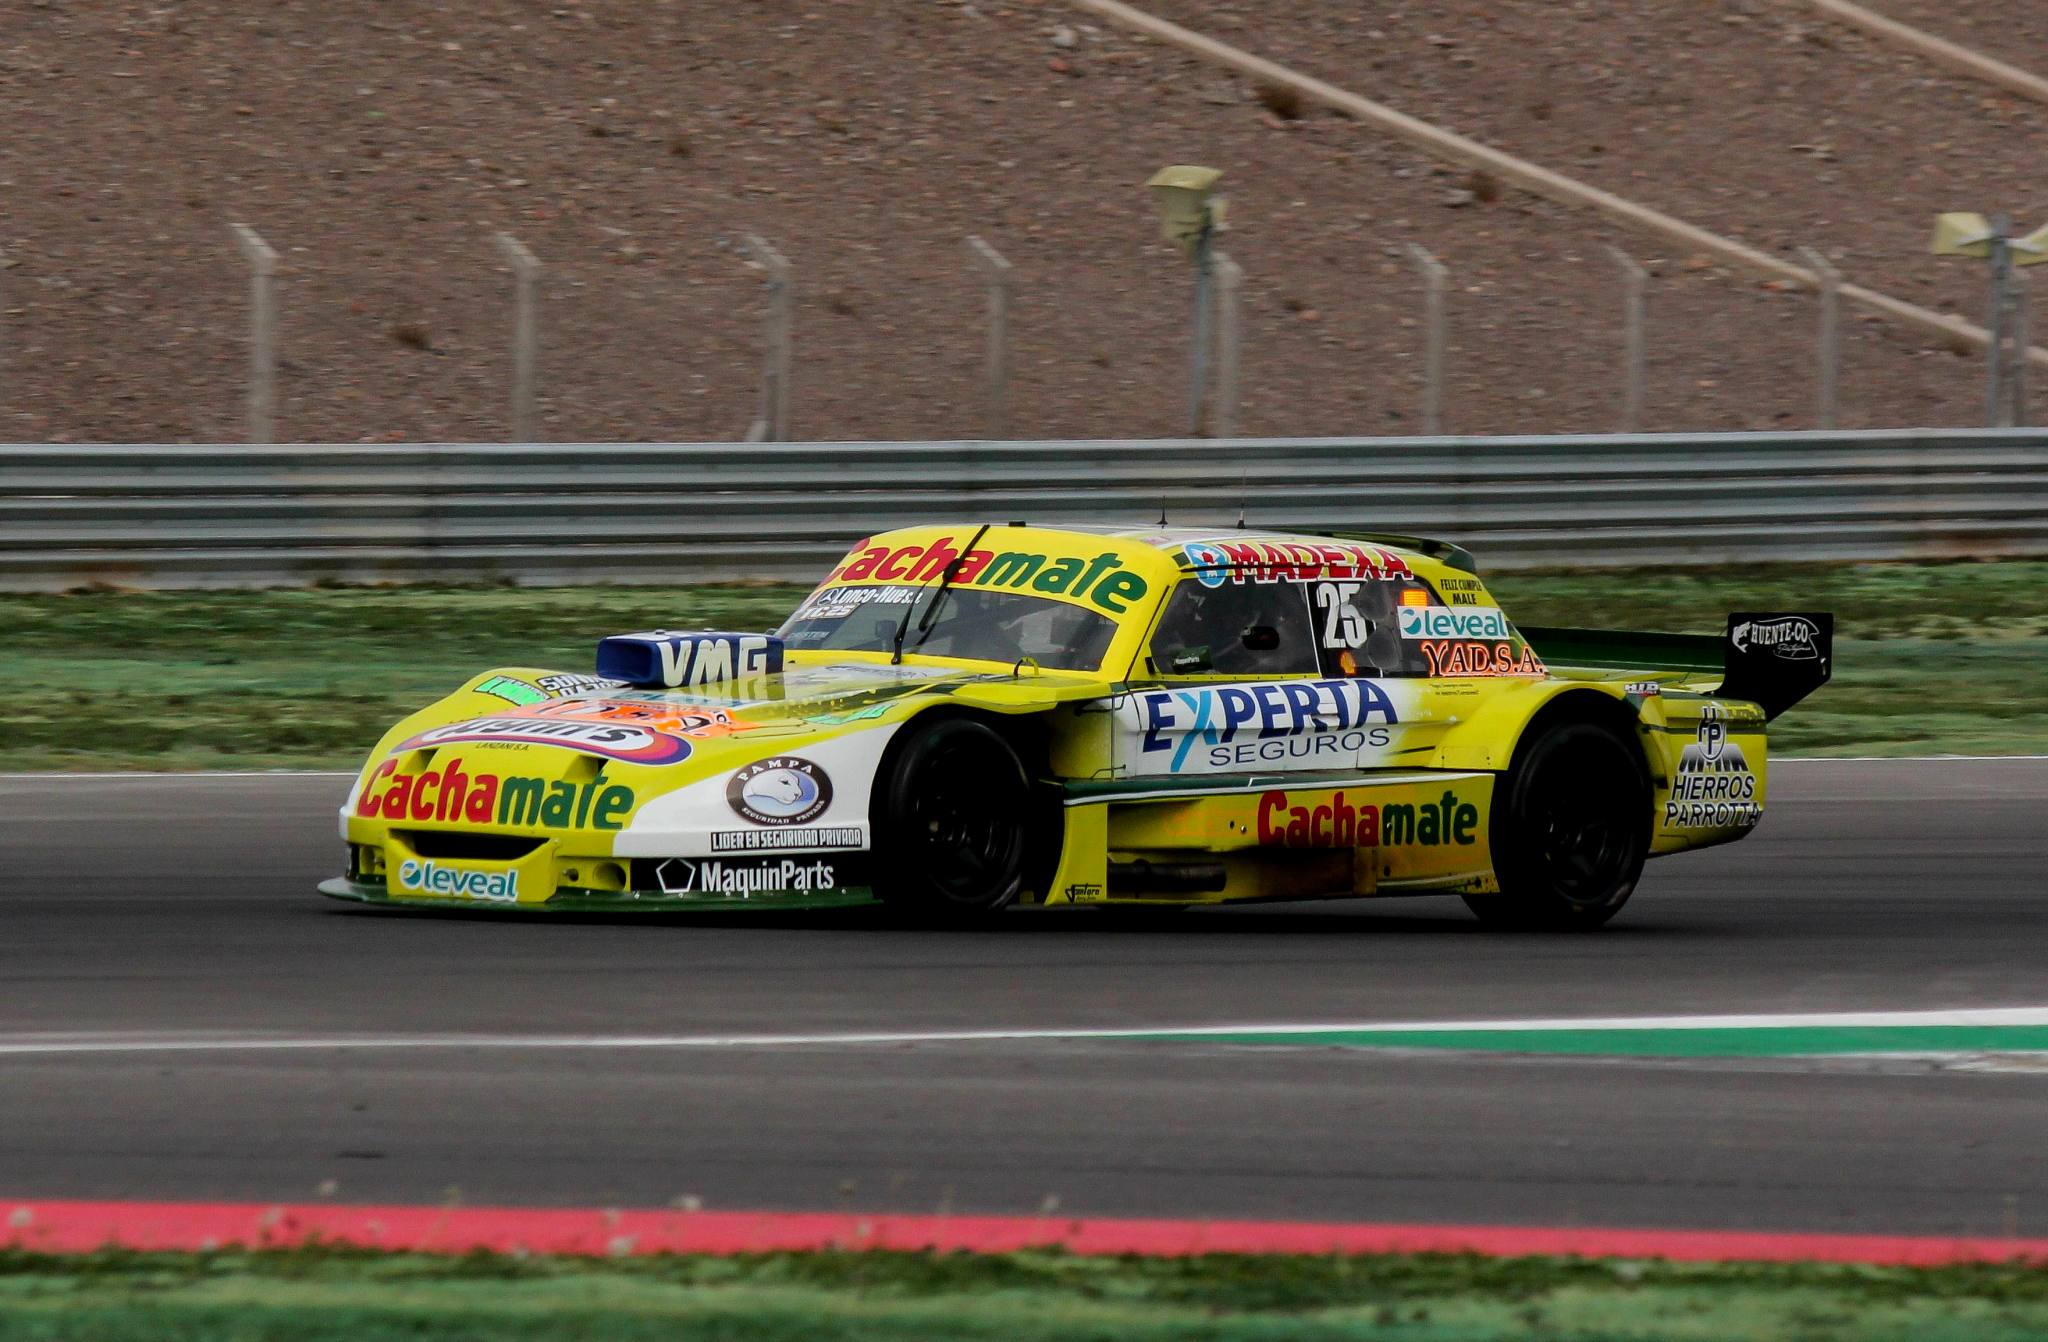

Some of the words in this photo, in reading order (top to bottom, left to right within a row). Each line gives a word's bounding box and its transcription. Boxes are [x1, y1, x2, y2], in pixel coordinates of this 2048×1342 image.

[819, 537, 1148, 614] Cachamate
[1217, 543, 1414, 584] MADEXA
[1440, 579, 1459, 591] FELIZ
[1453, 593, 1477, 605] MALE
[1317, 583, 1368, 649] 25
[1424, 610, 1507, 637] leveal
[656, 637, 768, 688] VMG
[1143, 679, 1398, 773] EXPERTA
[1210, 728, 1390, 766] SEGUROS
[738, 759, 813, 782] PAMPA
[1671, 775, 1755, 801] HIERROS
[357, 758, 635, 830] Cachamate
[742, 806, 790, 825] SEGURIDAD
[796, 800, 825, 822] PRIVADA
[1257, 789, 1478, 848] Cachamate
[1664, 802, 1760, 828] PARROTTA
[712, 832, 744, 850] LIDER
[745, 831, 760, 849] EN
[760, 829, 818, 848] SEGURIDAD
[819, 828, 863, 847] PRIVADA
[424, 862, 518, 900] leveal
[701, 859, 834, 898] MaquinParts
